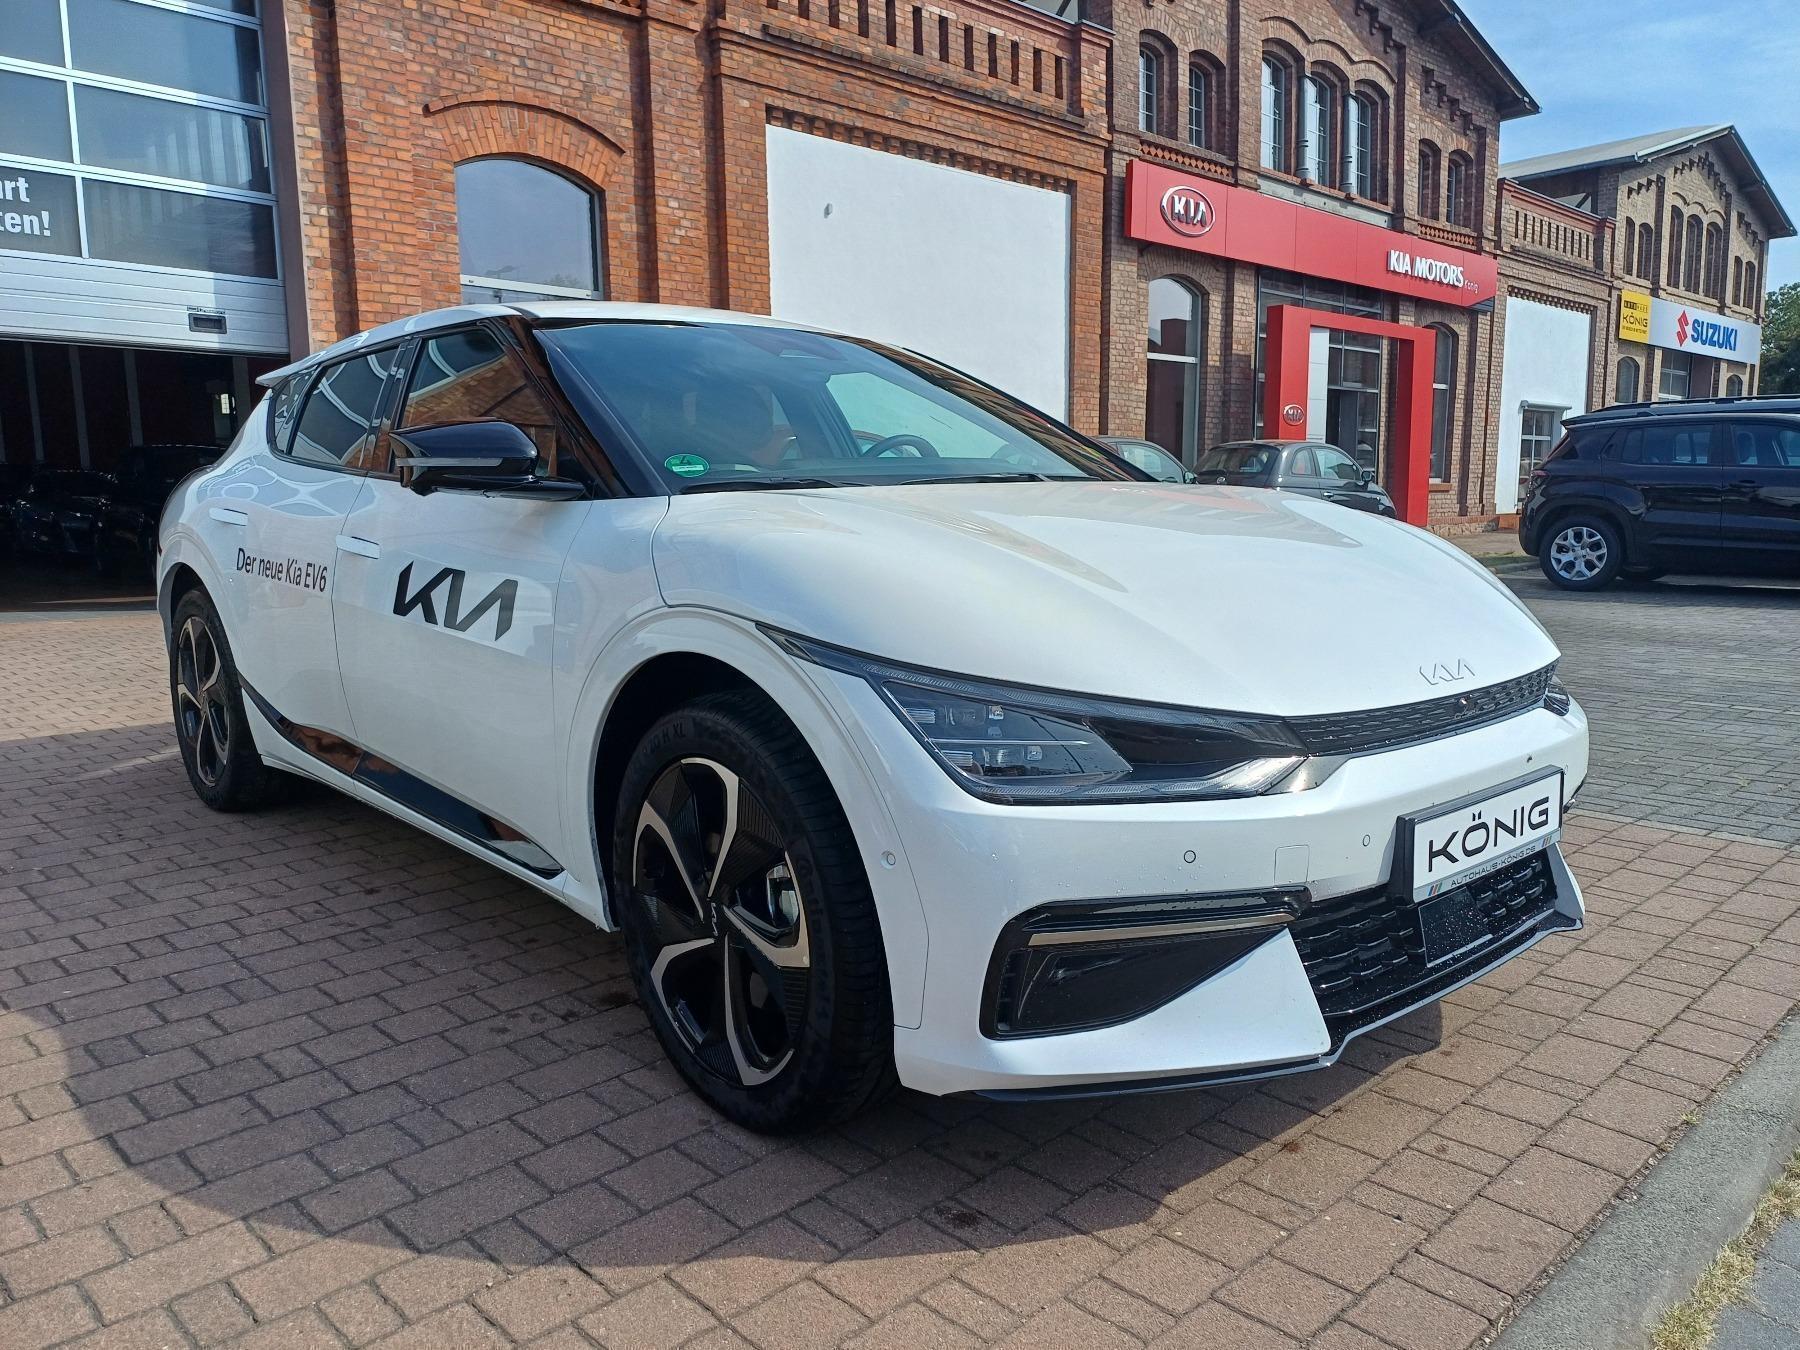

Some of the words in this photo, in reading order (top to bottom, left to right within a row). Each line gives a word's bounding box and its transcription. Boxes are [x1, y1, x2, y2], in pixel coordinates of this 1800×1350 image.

[1171, 194, 1206, 227] KIA
[1389, 250, 1412, 275] KIA
[1413, 256, 1464, 287] MOTORS
[1691, 318, 1738, 351] SUZUKI
[236, 547, 256, 574] Der
[258, 557, 283, 581] neue
[285, 558, 302, 586] Kia
[304, 562, 327, 592] EV6
[393, 560, 518, 641] KIA
[1428, 796, 1549, 873] KÖNIG
